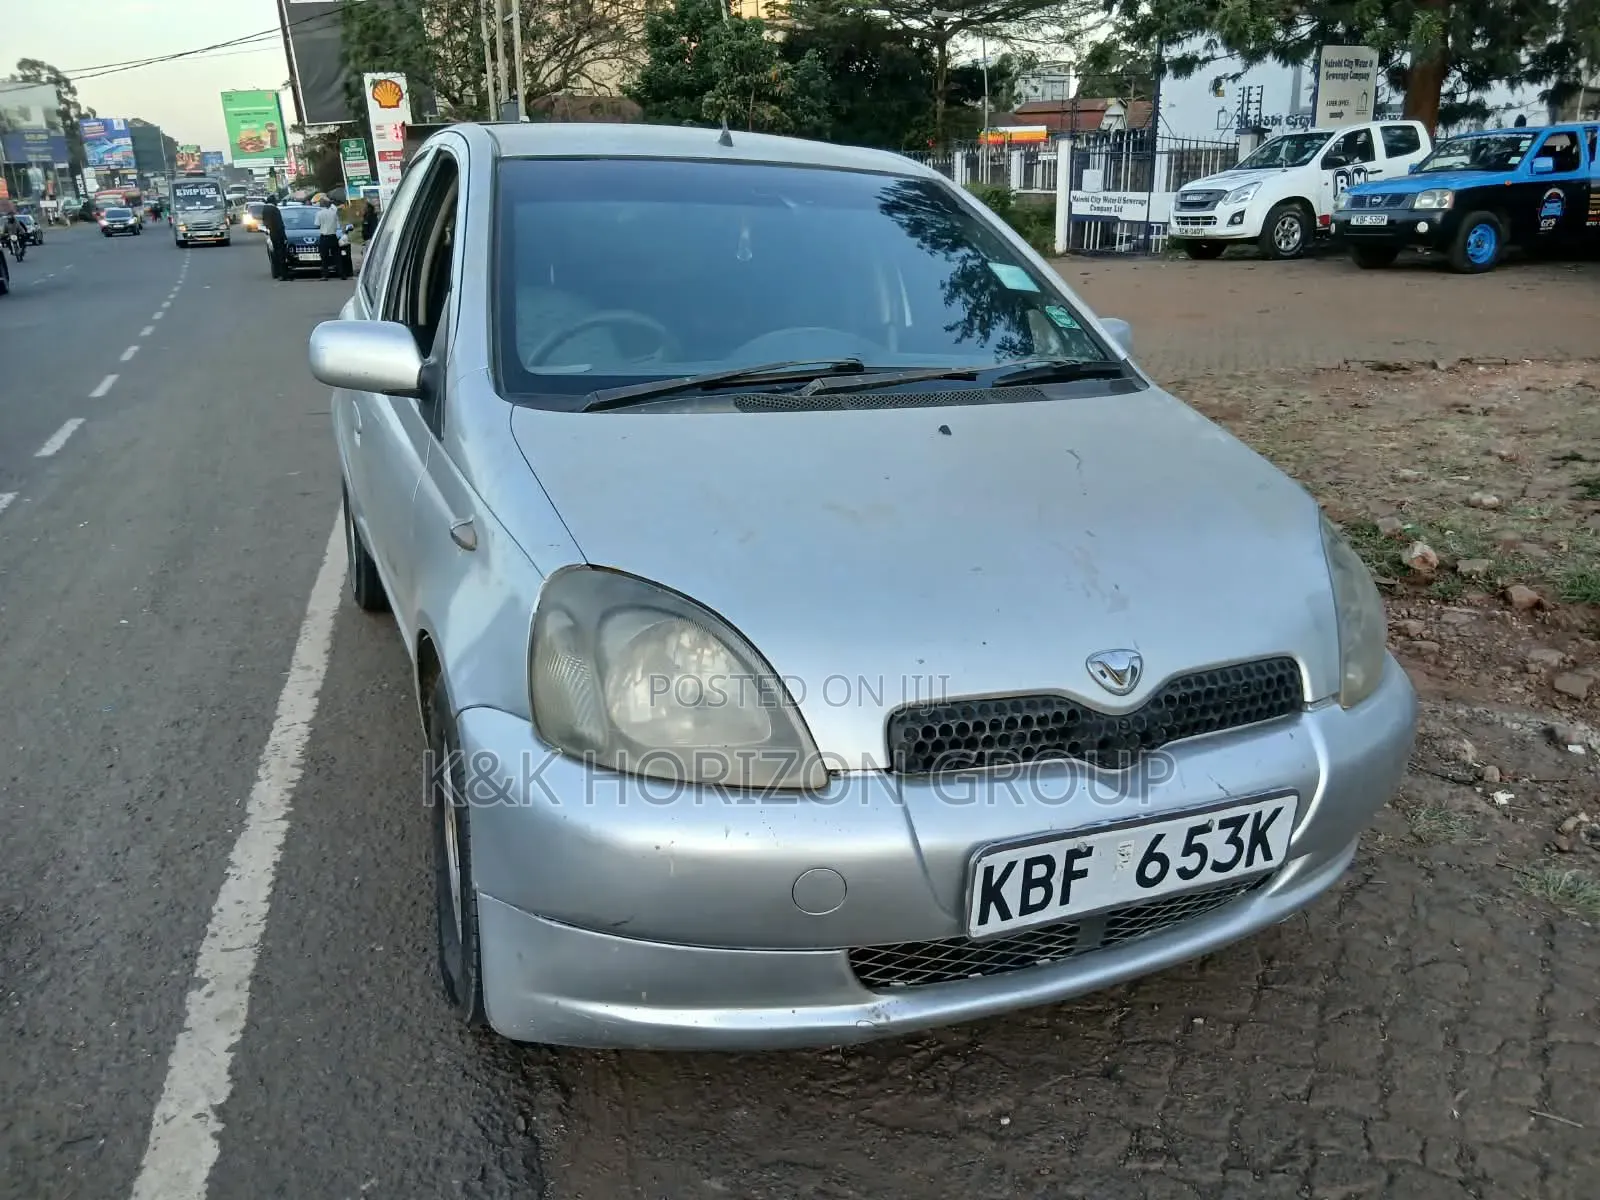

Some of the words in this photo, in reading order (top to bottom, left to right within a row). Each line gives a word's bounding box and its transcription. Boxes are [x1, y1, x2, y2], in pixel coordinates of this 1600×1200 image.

[1344, 59, 1353, 69] City
[176, 187, 217, 197] EMPIRE
[1091, 195, 1101, 204] City
[977, 845, 1095, 927] KBF
[1135, 806, 1285, 889] 653K
